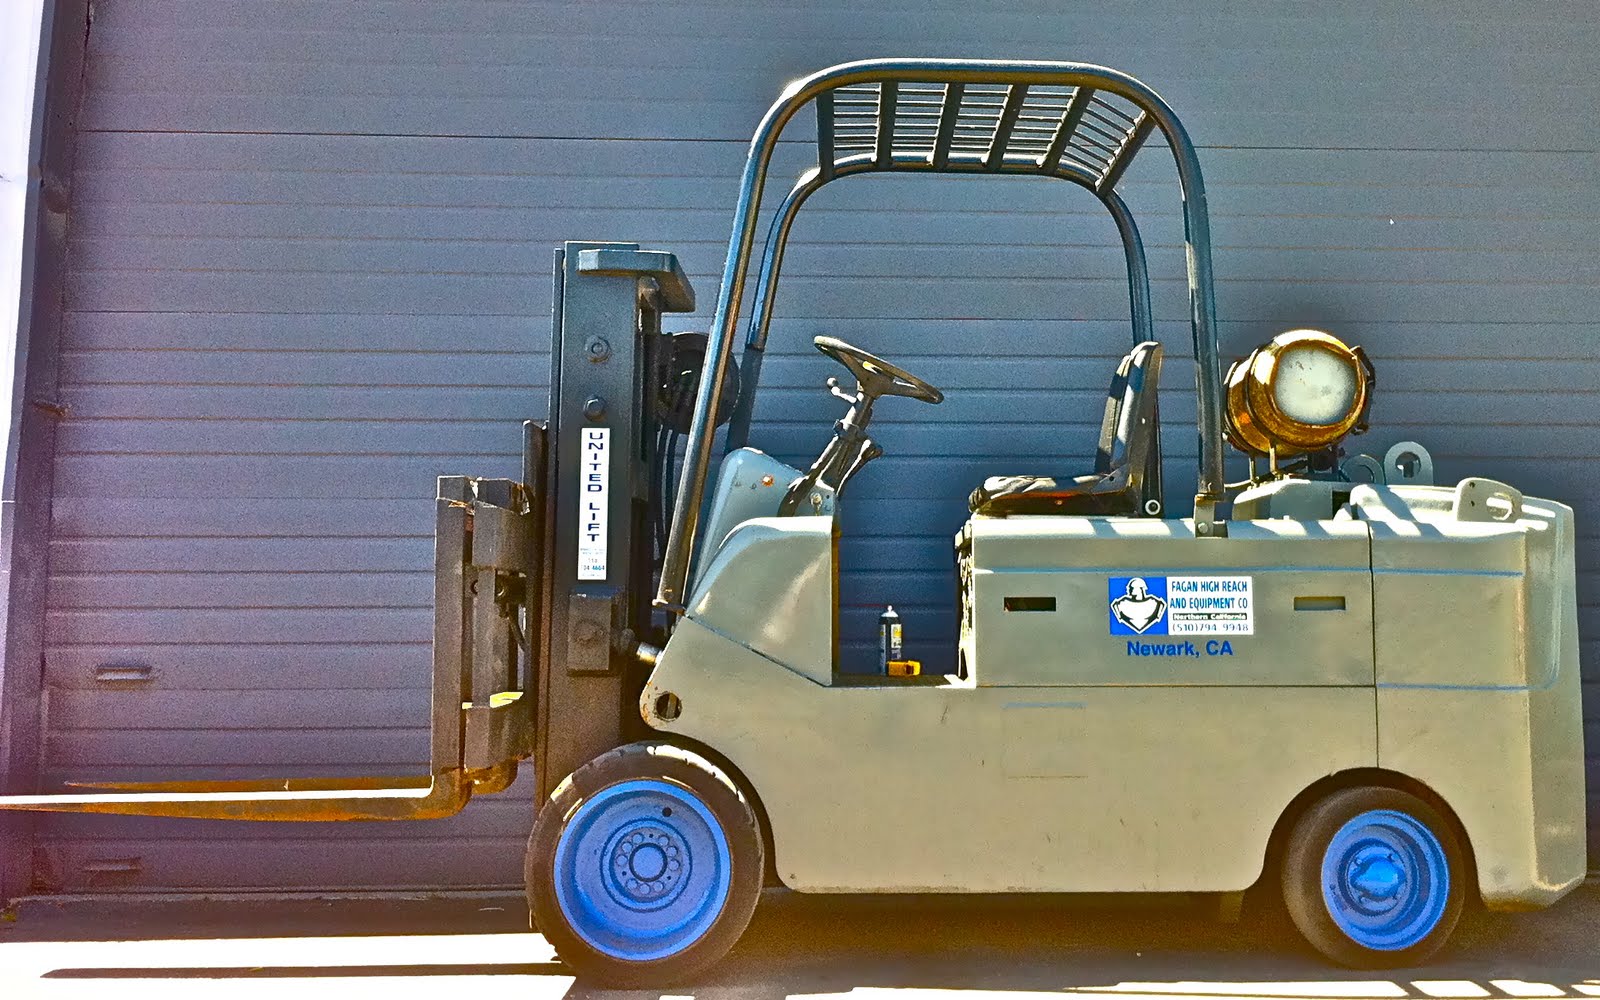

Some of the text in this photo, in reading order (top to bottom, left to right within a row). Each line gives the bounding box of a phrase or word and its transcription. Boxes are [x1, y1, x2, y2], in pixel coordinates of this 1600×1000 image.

[587, 432, 604, 492] UNITED
[586, 502, 601, 542] LIFT
[1171, 580, 1248, 592] FAGAN HIGH REACH
[1169, 597, 1248, 611] AND EQUIPMENT CO
[1173, 613, 1247, 621] Northern California
[1127, 640, 1234, 658] Newark, CA
